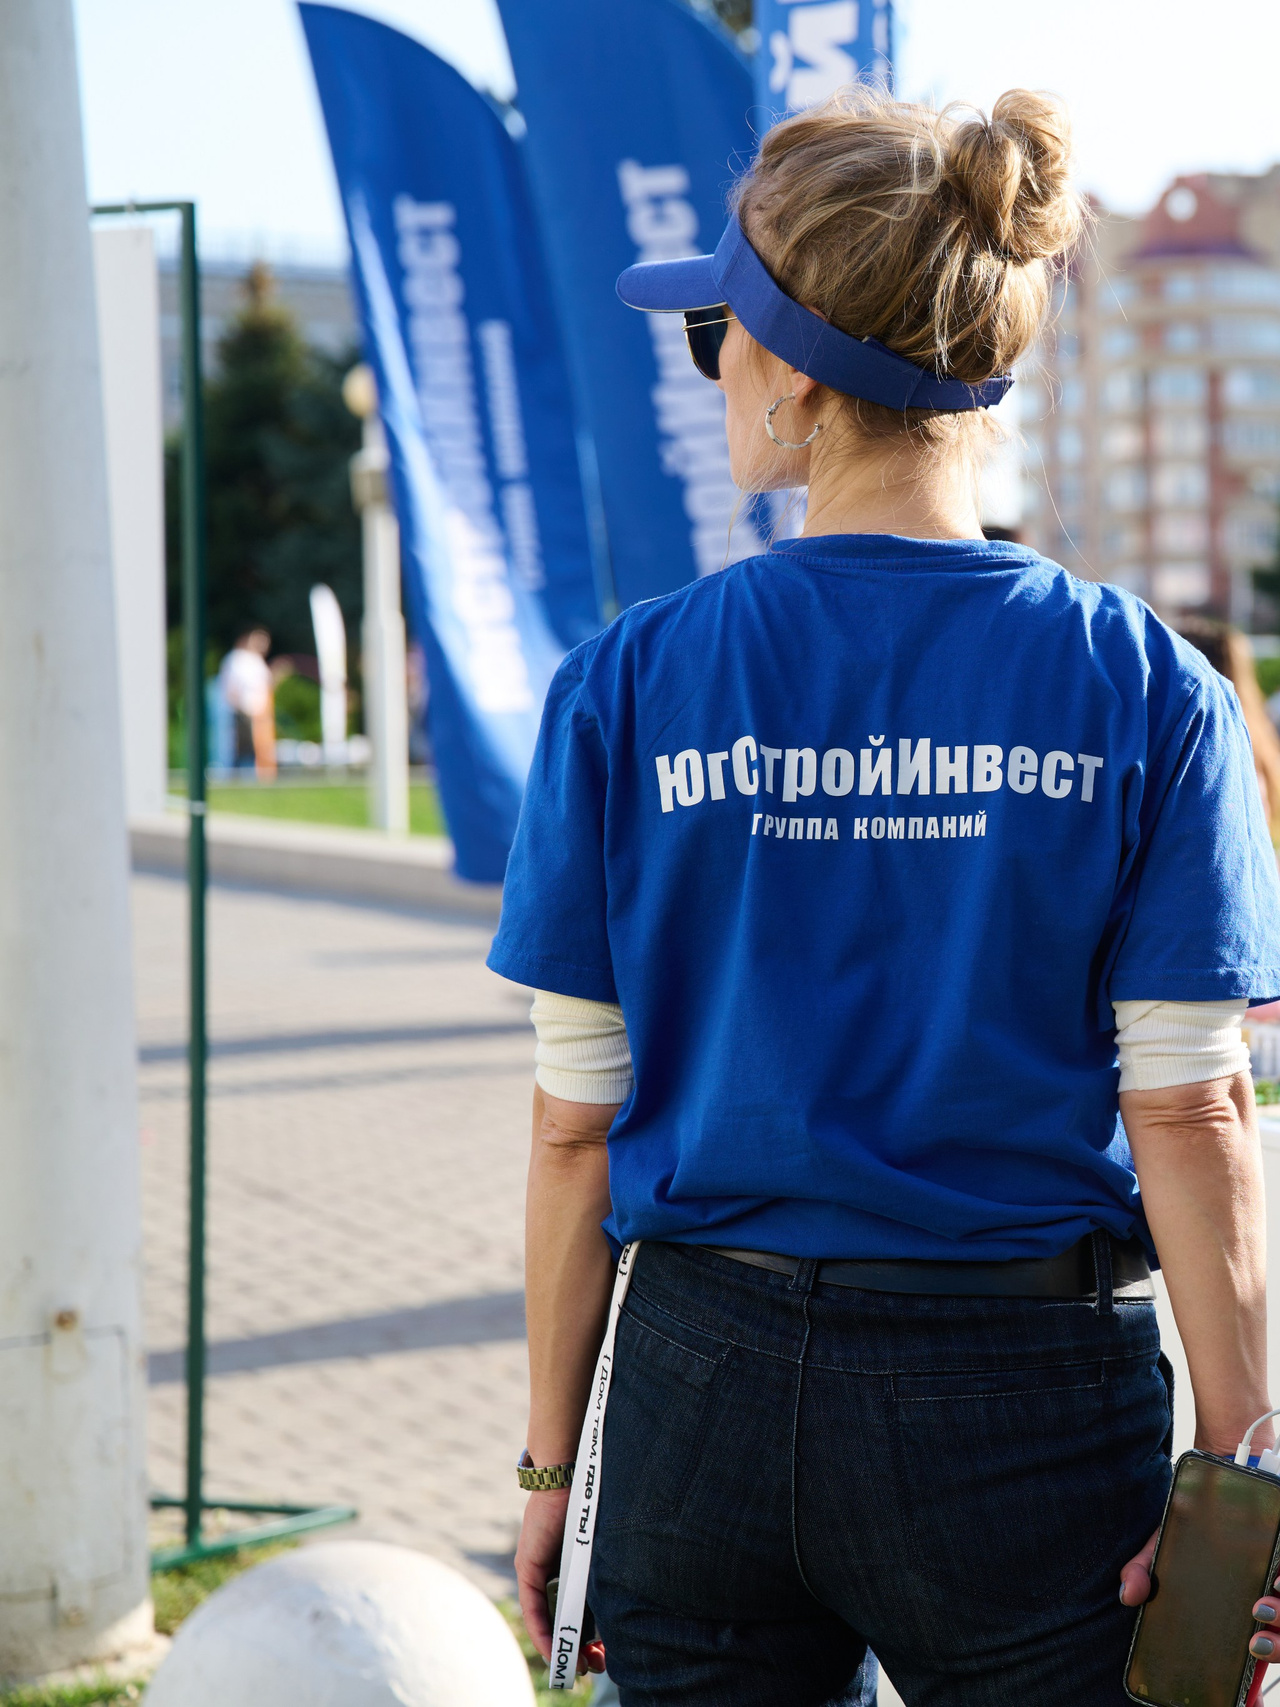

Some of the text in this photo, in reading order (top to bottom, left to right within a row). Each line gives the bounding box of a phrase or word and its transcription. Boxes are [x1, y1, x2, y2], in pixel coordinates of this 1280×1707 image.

[655, 735, 1104, 813] ЮгСтройИнвест
[752, 810, 987, 840] ГРУППА КОМПАНИЙ
[555, 1637, 573, 1679] Дом
